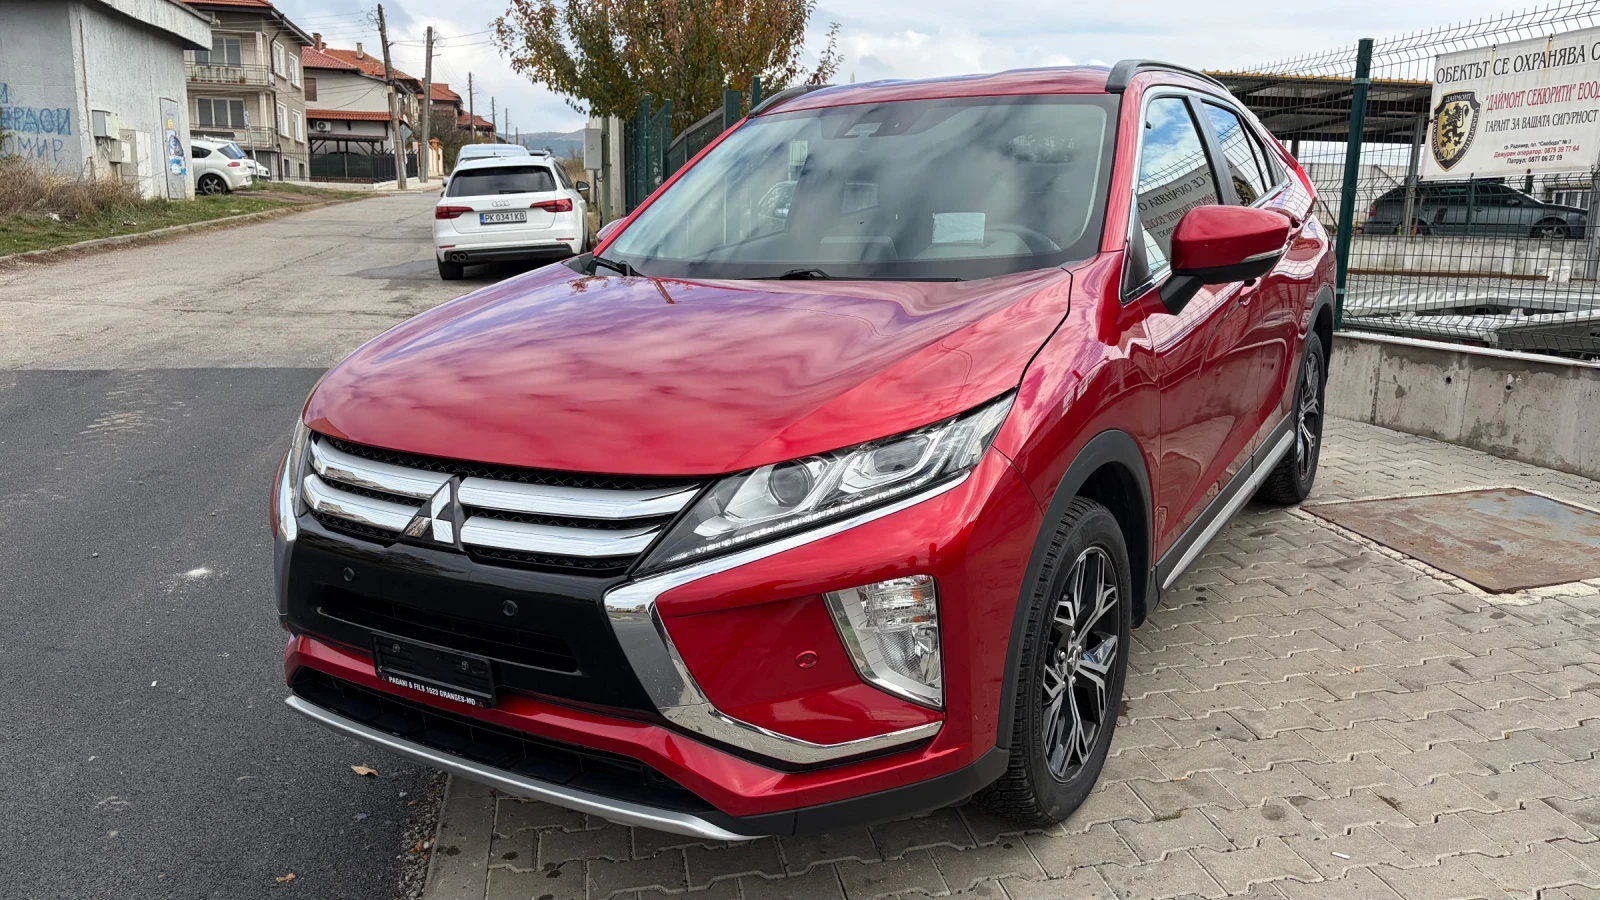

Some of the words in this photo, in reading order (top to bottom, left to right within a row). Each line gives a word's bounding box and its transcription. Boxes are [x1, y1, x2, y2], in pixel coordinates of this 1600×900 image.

[1436, 60, 1490, 84] ОБЕКТЪТ
[1493, 57, 1510, 76] СЕ
[1513, 44, 1586, 73] ОХРАНЯВА
[1485, 118, 1510, 133] ГАРАНТ
[1510, 117, 1520, 130] ЗА
[1521, 114, 1550, 129] ВАШАТА
[1552, 109, 1600, 126] СИГУРНОСТ
[495, 213, 513, 221] 0341
[388, 676, 408, 687] PAGANI
[408, 681, 413, 689] &
[413, 682, 425, 692] FILS
[426, 686, 439, 696] 1523
